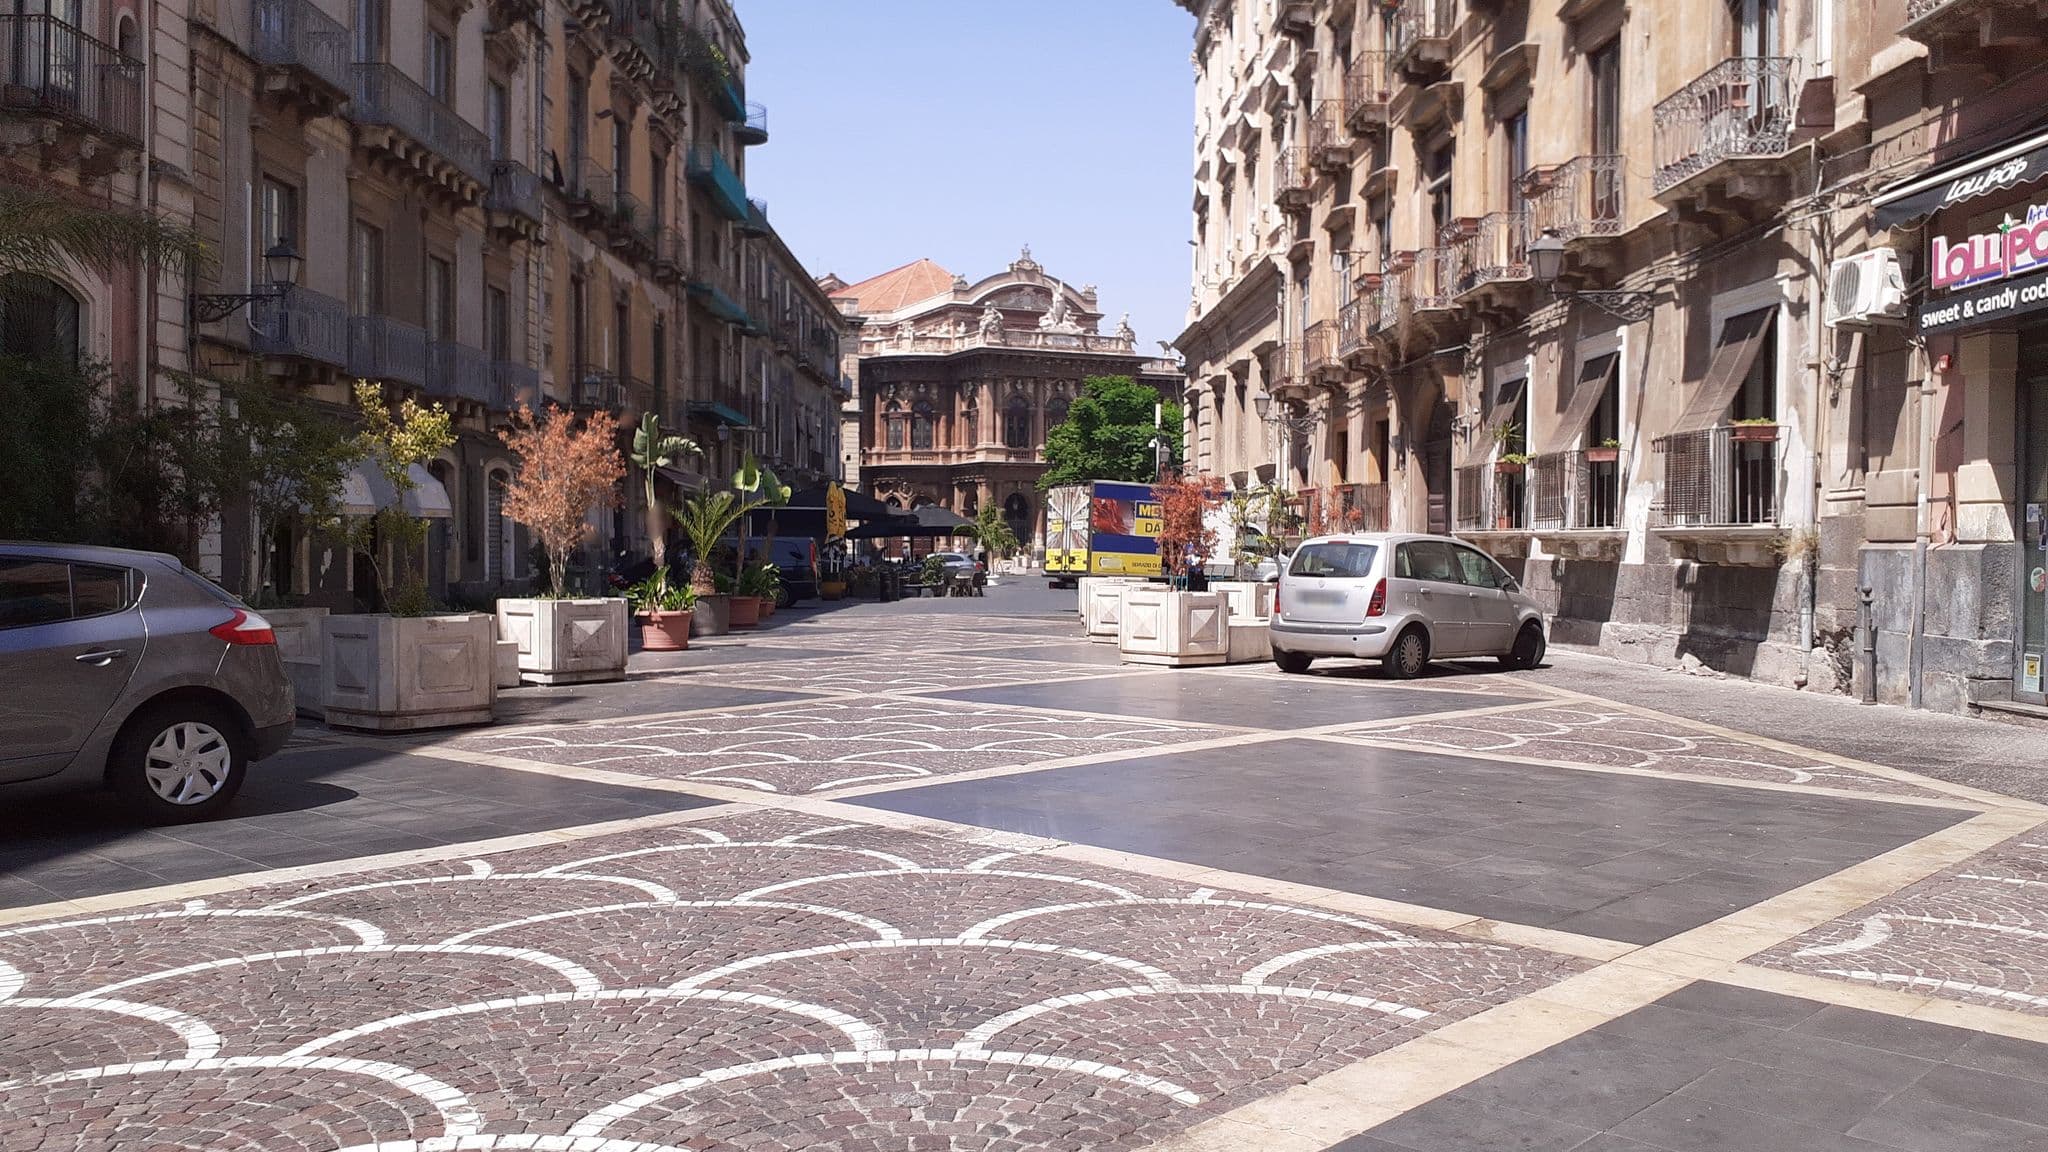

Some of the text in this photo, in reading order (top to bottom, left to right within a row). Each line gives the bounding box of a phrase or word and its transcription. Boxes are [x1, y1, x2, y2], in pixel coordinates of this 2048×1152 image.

[1921, 303, 1960, 329] sweet
[1963, 300, 1974, 318] &
[1976, 287, 2018, 309] candy
